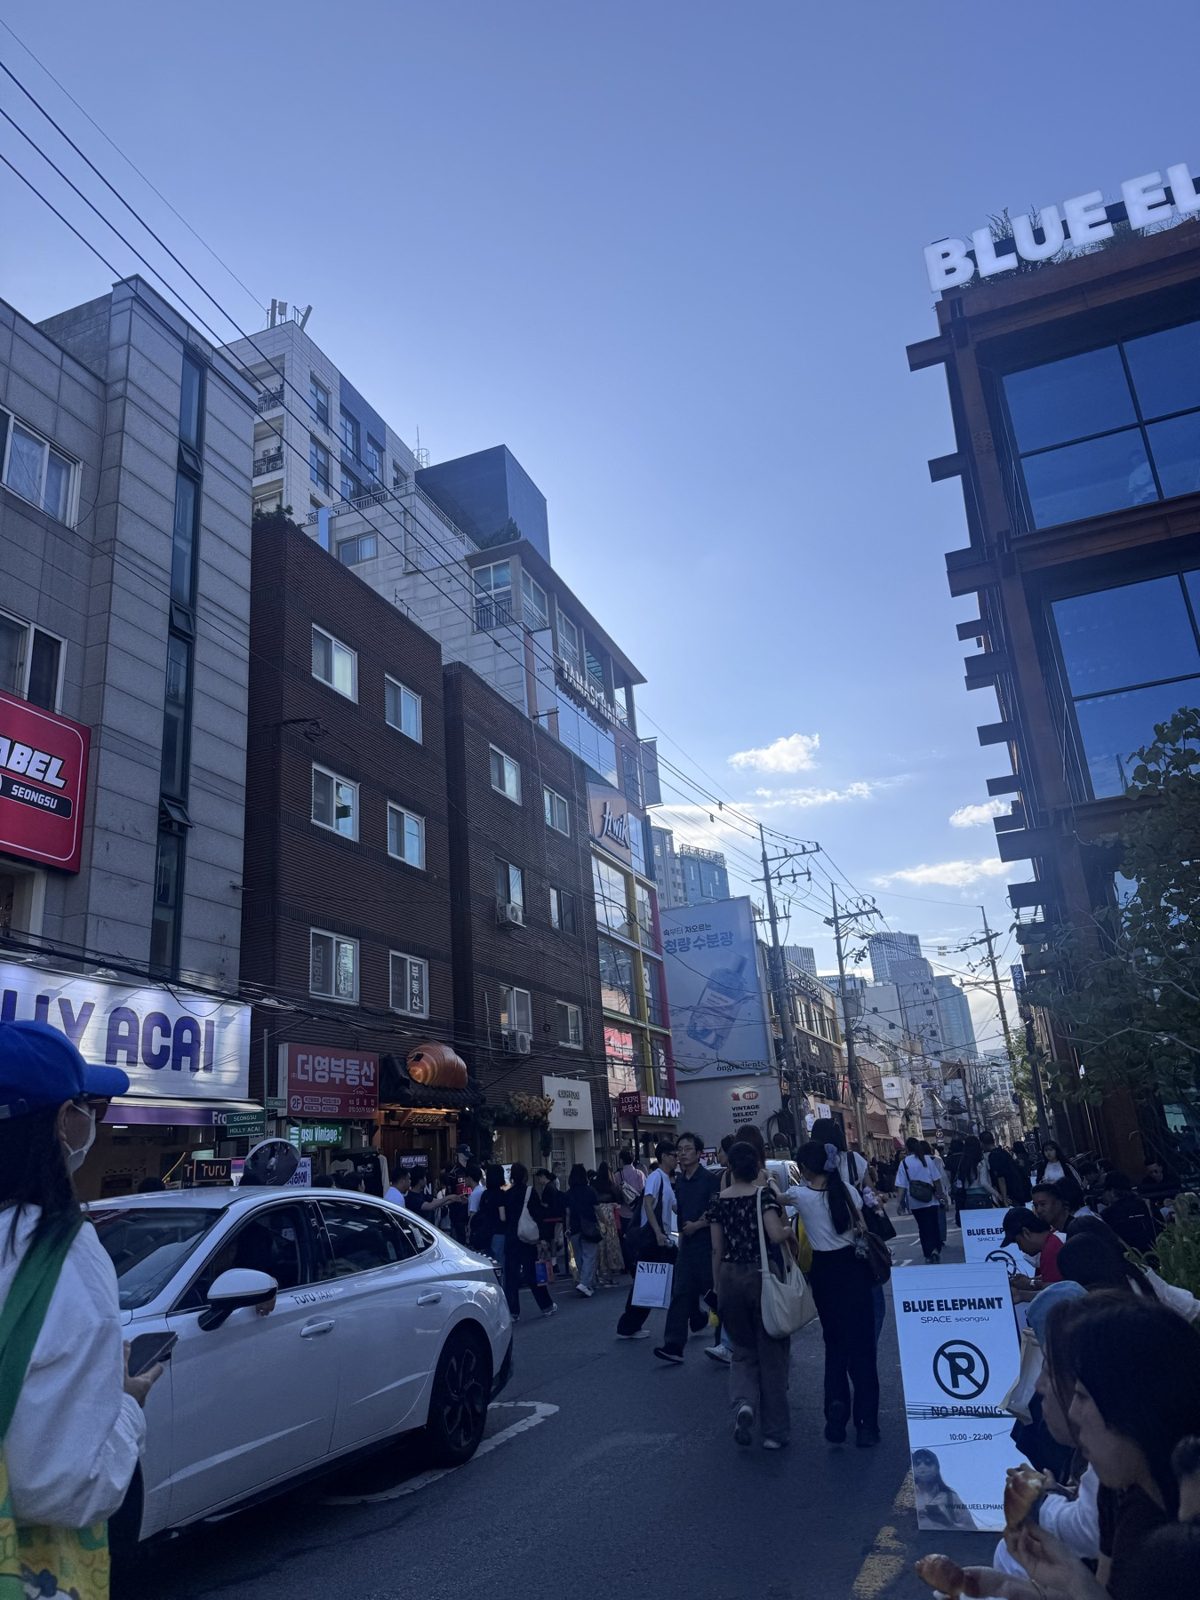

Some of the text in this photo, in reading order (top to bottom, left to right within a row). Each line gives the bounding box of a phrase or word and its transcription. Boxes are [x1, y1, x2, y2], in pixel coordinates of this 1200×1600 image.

[923, 163, 1200, 293] BLUE EL
[11, 784, 58, 809] SEONGSU
[664, 931, 734, 954] 청량 수분광
[105, 1007, 215, 1073] ACAI
[297, 1054, 376, 1087] 더영부동산
[665, 1098, 681, 1118] POP
[314, 1126, 338, 1143] Vintage
[967, 1228, 986, 1236] BLUE
[902, 1296, 1004, 1313] BLUE ELEPHANT
[920, 1315, 990, 1324] SPACE seongsu
[931, 1406, 1003, 1418] NO PARKING
[949, 1433, 967, 1442] 10:00
[973, 1432, 993, 1441] 22:00
